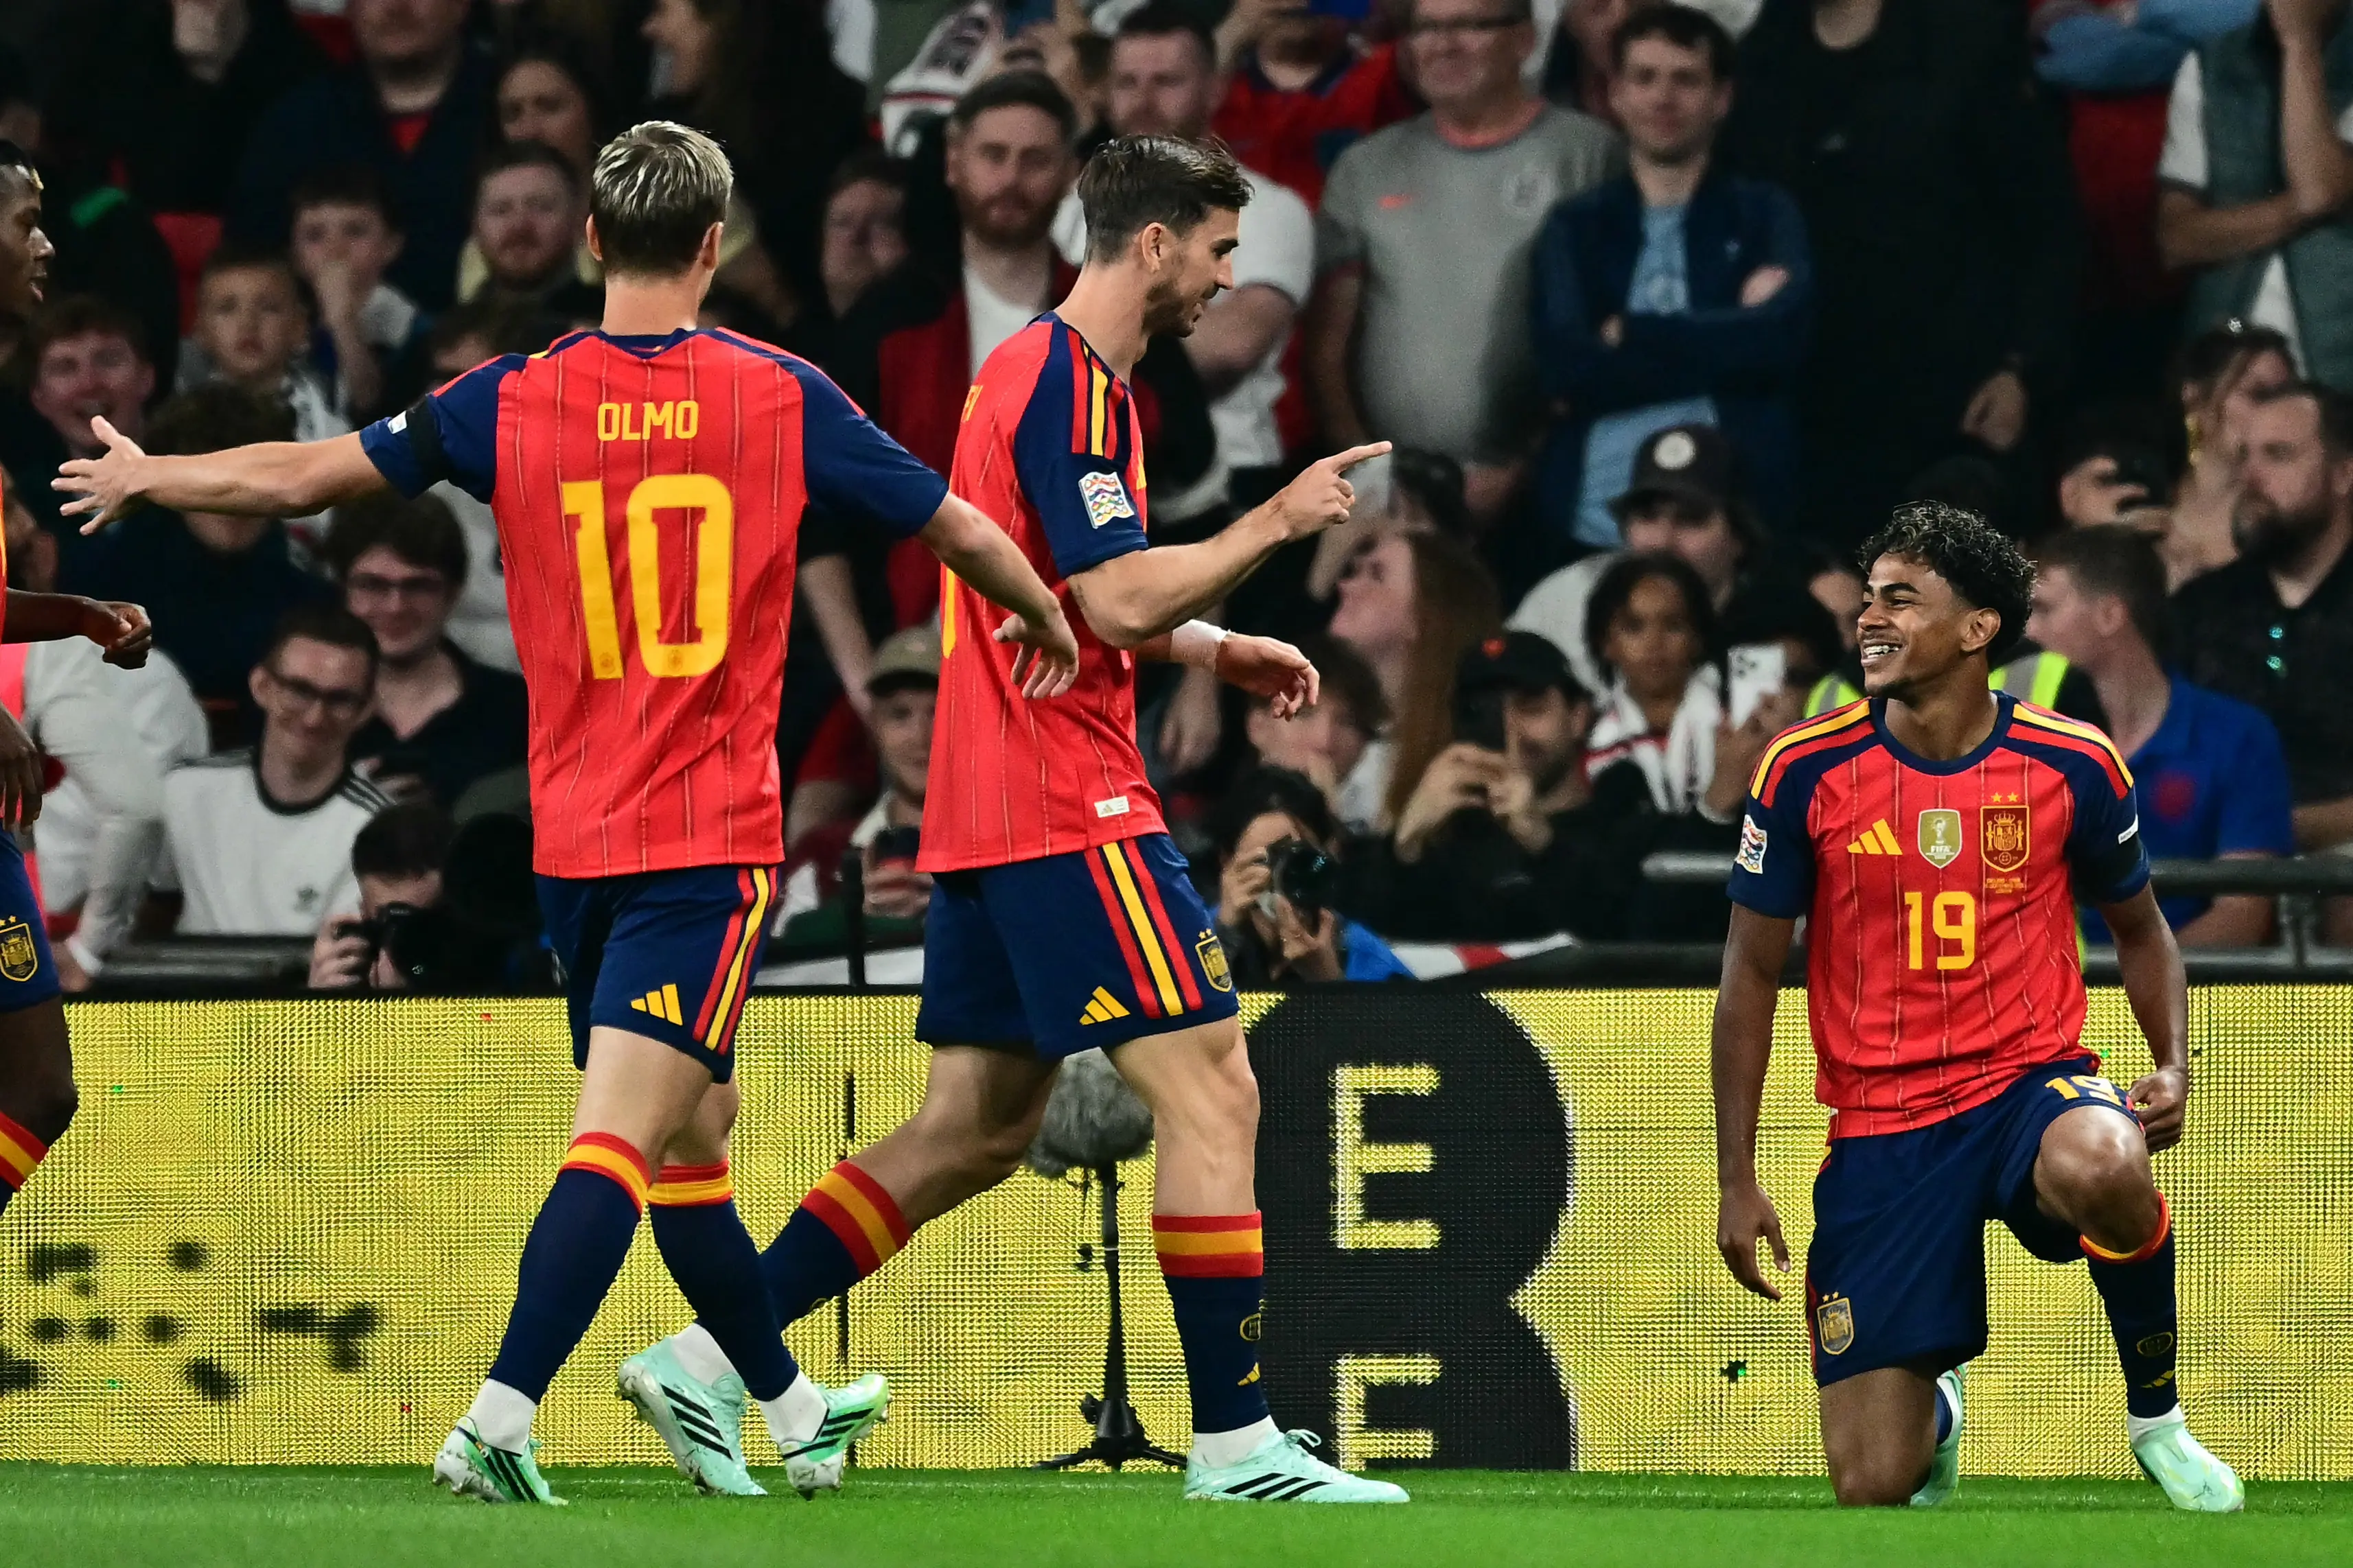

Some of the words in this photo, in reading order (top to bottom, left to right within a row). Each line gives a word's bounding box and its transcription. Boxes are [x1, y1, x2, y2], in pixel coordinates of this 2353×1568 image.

[597, 401, 699, 441] OLMO
[561, 474, 732, 679] 10
[1905, 891, 1975, 970] 19
[2045, 1075, 2122, 1106] 19
[1331, 1062, 1440, 1250] E
